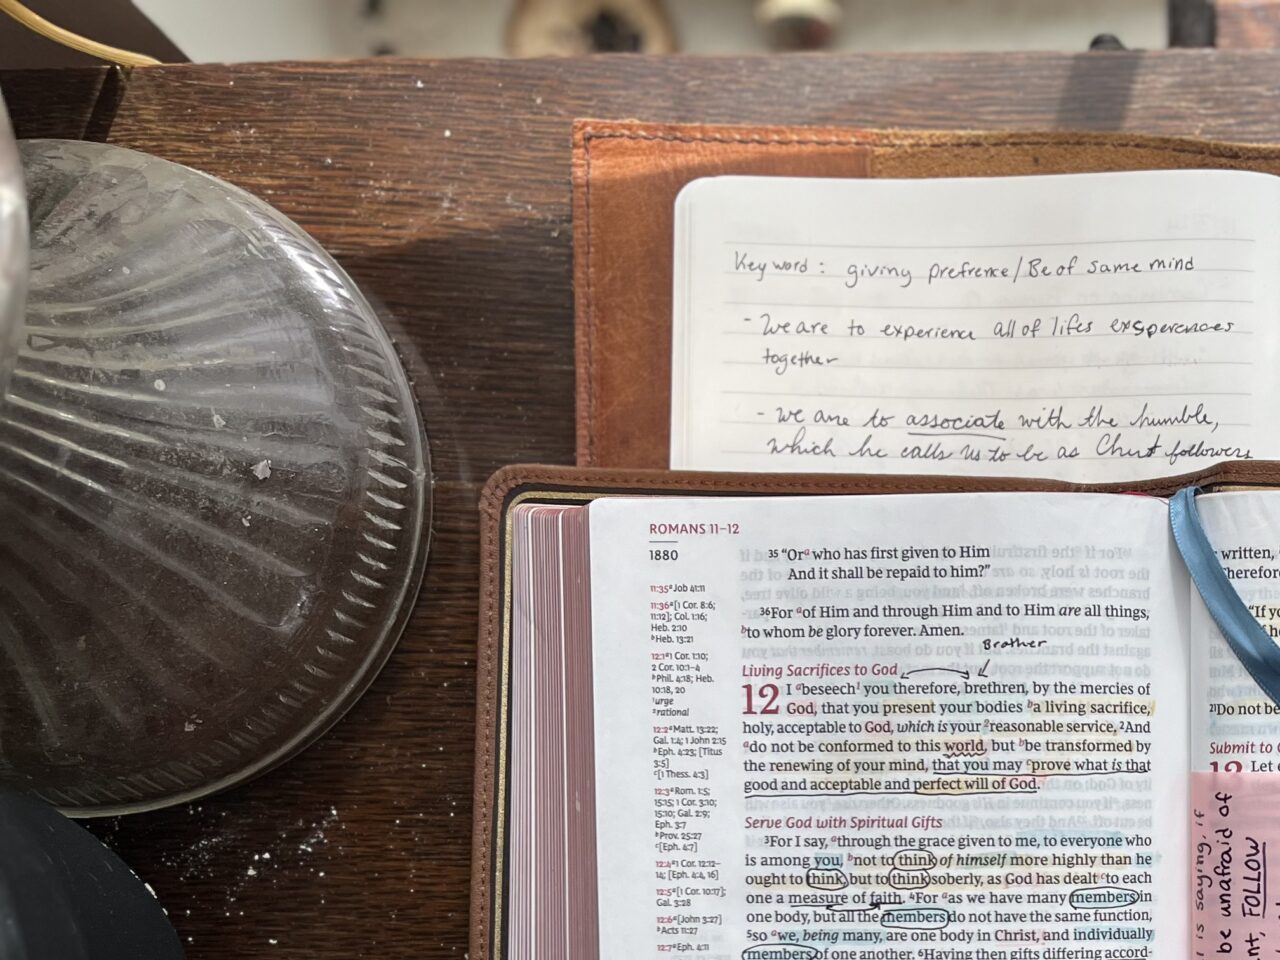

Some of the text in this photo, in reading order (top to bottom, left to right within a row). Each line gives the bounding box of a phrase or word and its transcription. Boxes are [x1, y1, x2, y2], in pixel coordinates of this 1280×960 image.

[845, 264, 912, 288] giving
[1056, 256, 1078, 276] of
[1149, 256, 1195, 271] mind
[796, 321, 828, 335] are
[848, 319, 865, 336] to
[1022, 318, 1041, 338] of
[762, 348, 839, 375] together
[814, 410, 850, 427] are
[863, 408, 895, 428] to
[906, 410, 1005, 430] associate
[1018, 406, 1072, 429] with
[1078, 406, 1118, 428] the
[848, 435, 888, 458] he
[901, 443, 953, 460] calls
[960, 446, 980, 461] us
[988, 446, 1010, 462] to
[1016, 444, 1048, 462] be
[1057, 447, 1080, 458] as
[649, 523, 740, 535] ROMANS 11–12
[649, 550, 679, 561] 1880
[811, 544, 991, 563] who has first given to Him
[1221, 546, 1275, 561] written,
[651, 623, 688, 632] Heb. 2:10
[742, 662, 898, 680] Living Sacrifices to God
[742, 684, 780, 715] 12
[1209, 740, 1256, 755] Submit
[1259, 741, 1273, 754] to
[1250, 760, 1274, 773] Let
[1214, 792, 1233, 817] of
[744, 815, 943, 832] Serve God with Spiritual Gifts
[1193, 808, 1205, 827] if
[1215, 828, 1233, 918] unafraid
[1242, 836, 1263, 918] FOLLOW
[1195, 923, 1205, 940] is
[1213, 929, 1232, 953] be
